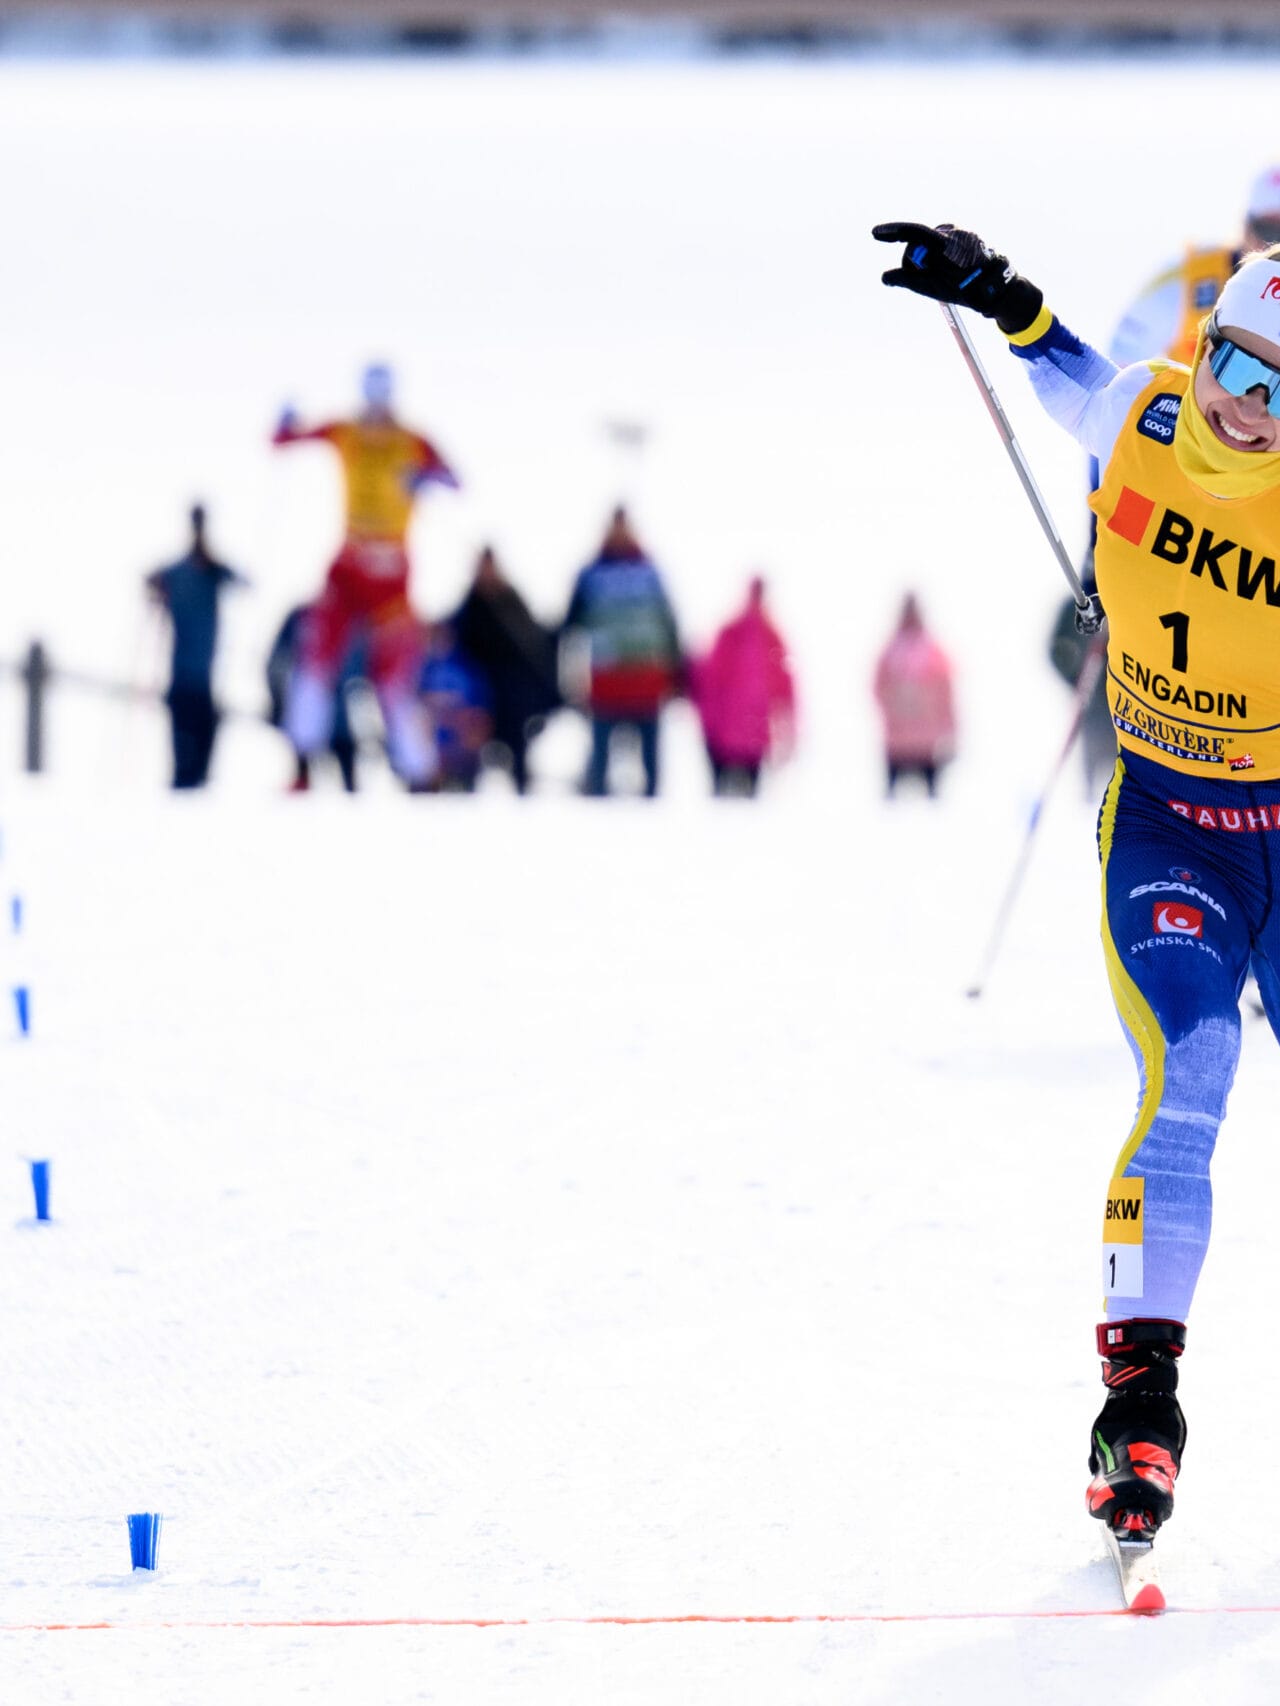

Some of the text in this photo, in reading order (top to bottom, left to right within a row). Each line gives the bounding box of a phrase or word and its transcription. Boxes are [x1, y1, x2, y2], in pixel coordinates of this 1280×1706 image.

[1144, 418, 1172, 437] coop
[1159, 611, 1189, 673] 1
[1122, 651, 1247, 719] ENGADIN
[1114, 691, 1133, 721] LE
[1115, 718, 1219, 762] SWITZERLAND
[1129, 881, 1227, 921] SCANIA
[1130, 936, 1223, 965] SVENSKA SPEL
[1106, 1199, 1141, 1220] BKW
[1109, 1253, 1116, 1288] 1
